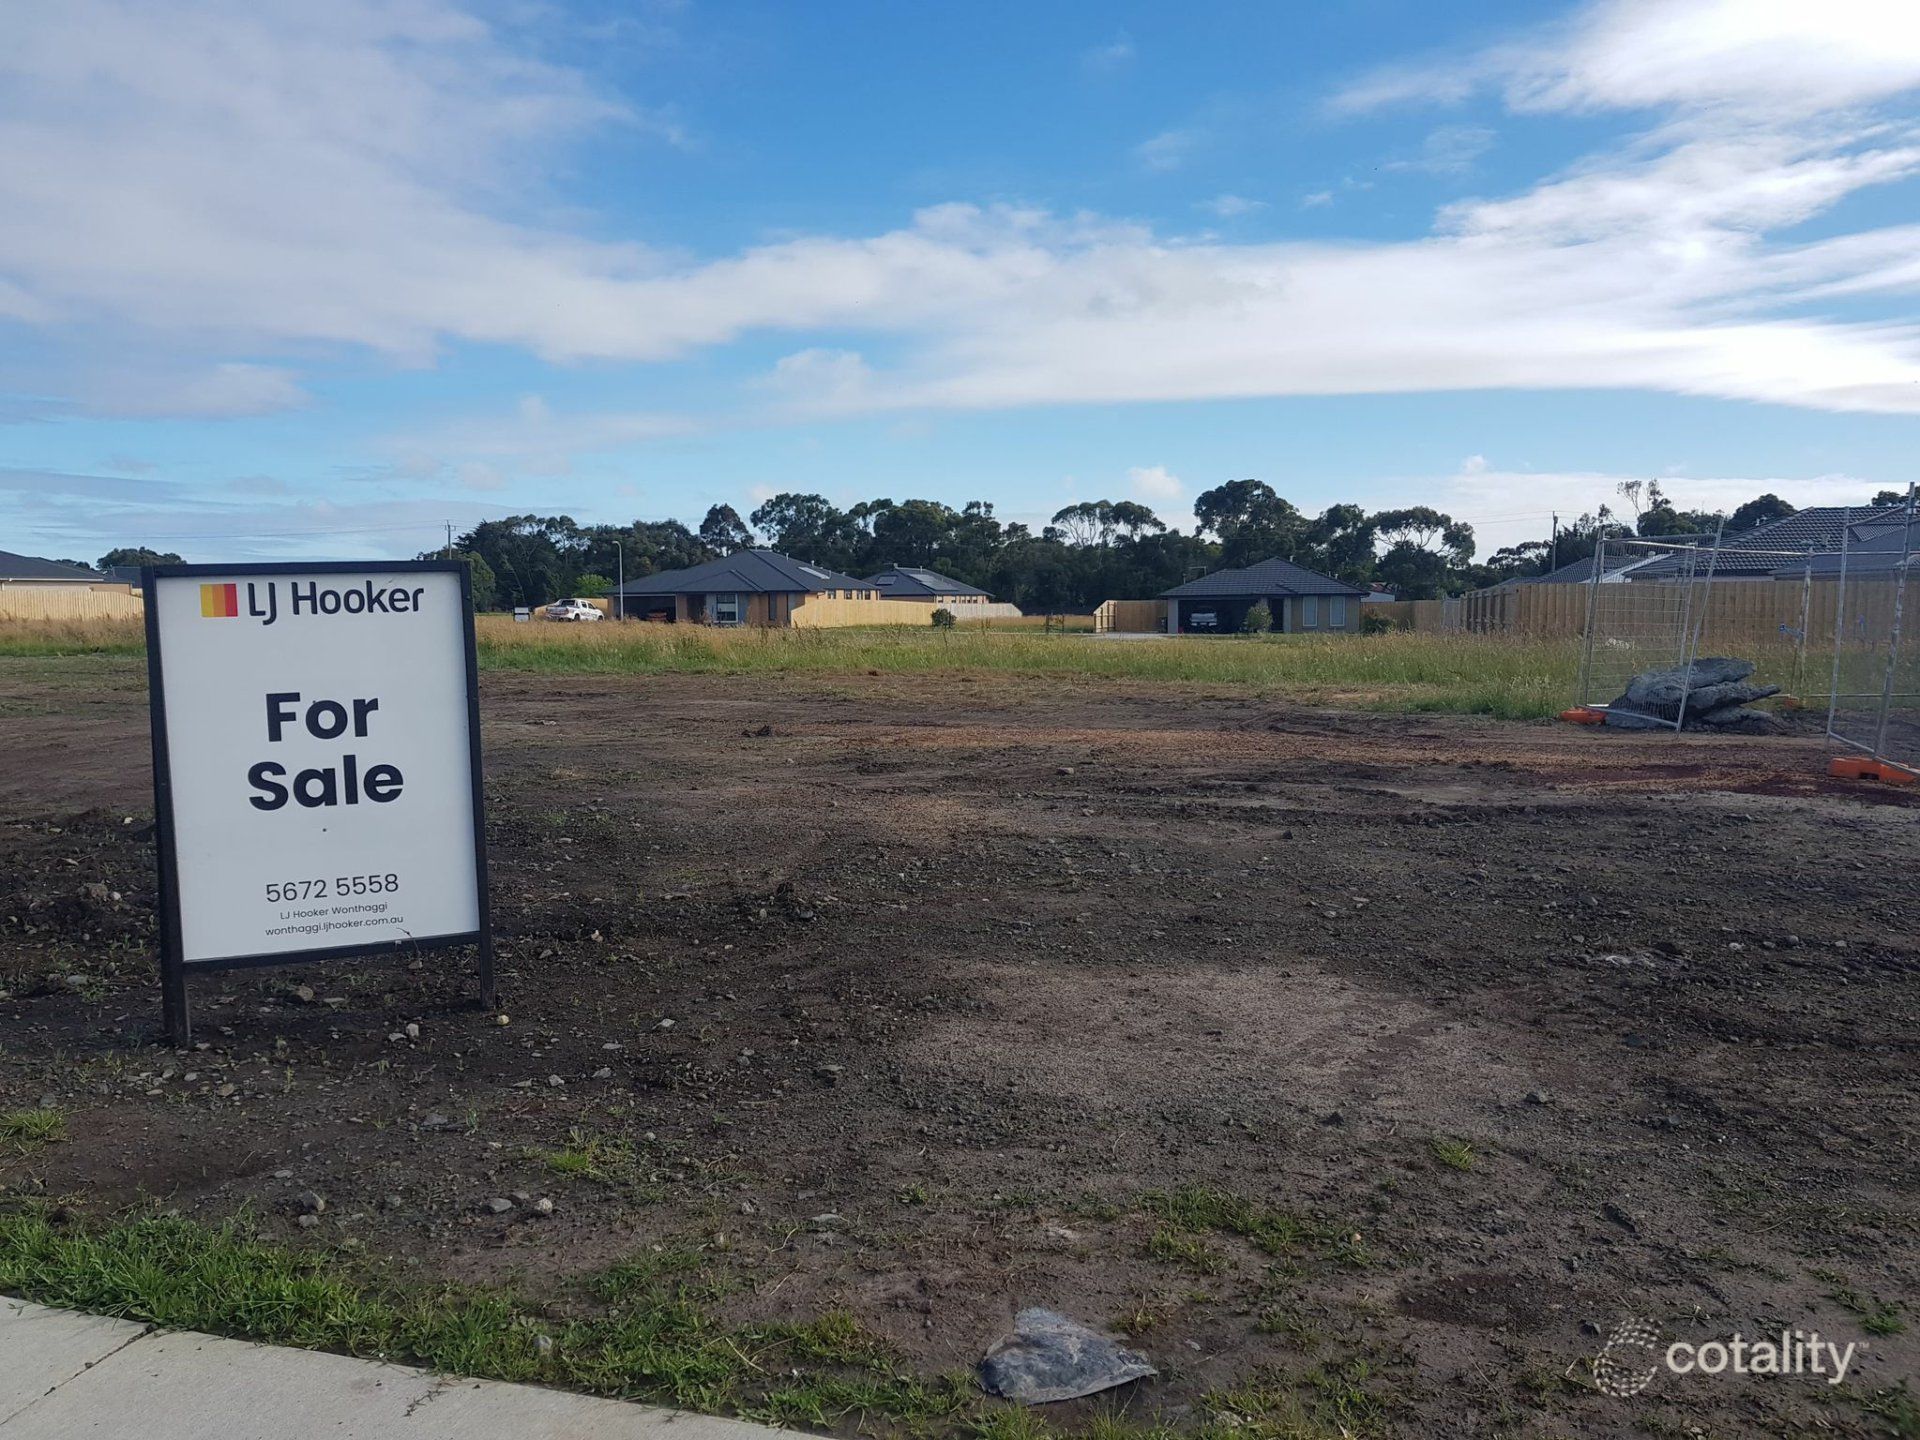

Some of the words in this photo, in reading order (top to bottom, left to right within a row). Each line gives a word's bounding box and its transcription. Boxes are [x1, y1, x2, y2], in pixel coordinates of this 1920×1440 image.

[247, 582, 276, 625] LJ
[291, 580, 424, 615] Hooker
[265, 691, 379, 742] For
[247, 754, 404, 811] Sale
[266, 879, 328, 903] 5672
[336, 873, 399, 897] 5558
[265, 916, 404, 936] wonthaggi.ljhooker.com.au
[280, 911, 290, 920] LJ
[293, 908, 329, 919] Hooker
[331, 902, 388, 915] Wonthaggi
